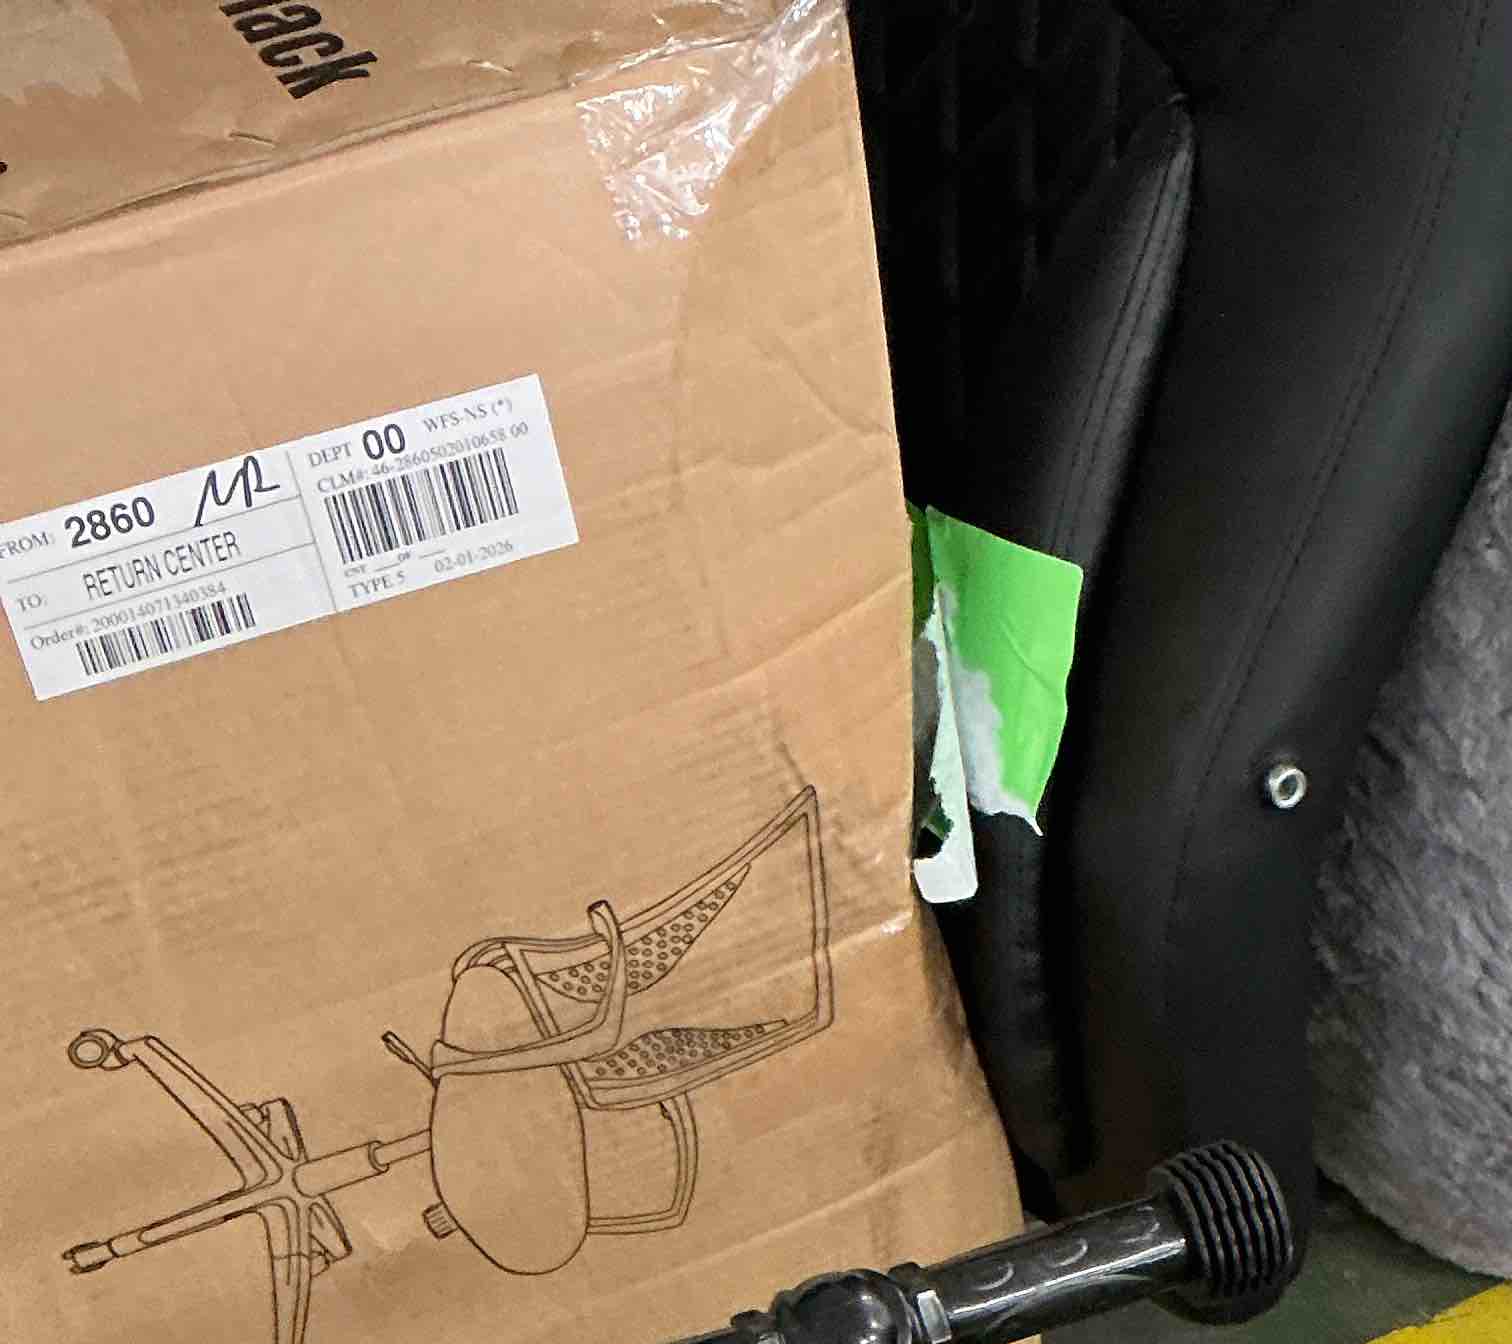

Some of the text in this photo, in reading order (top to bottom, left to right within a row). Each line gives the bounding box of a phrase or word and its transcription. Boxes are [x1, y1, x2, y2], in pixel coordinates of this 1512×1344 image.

[306, 420, 409, 468] DEPT 00
[61, 493, 158, 549] 2860
[80, 528, 242, 602] RETURN CENTER
[347, 572, 395, 599] TYPE
